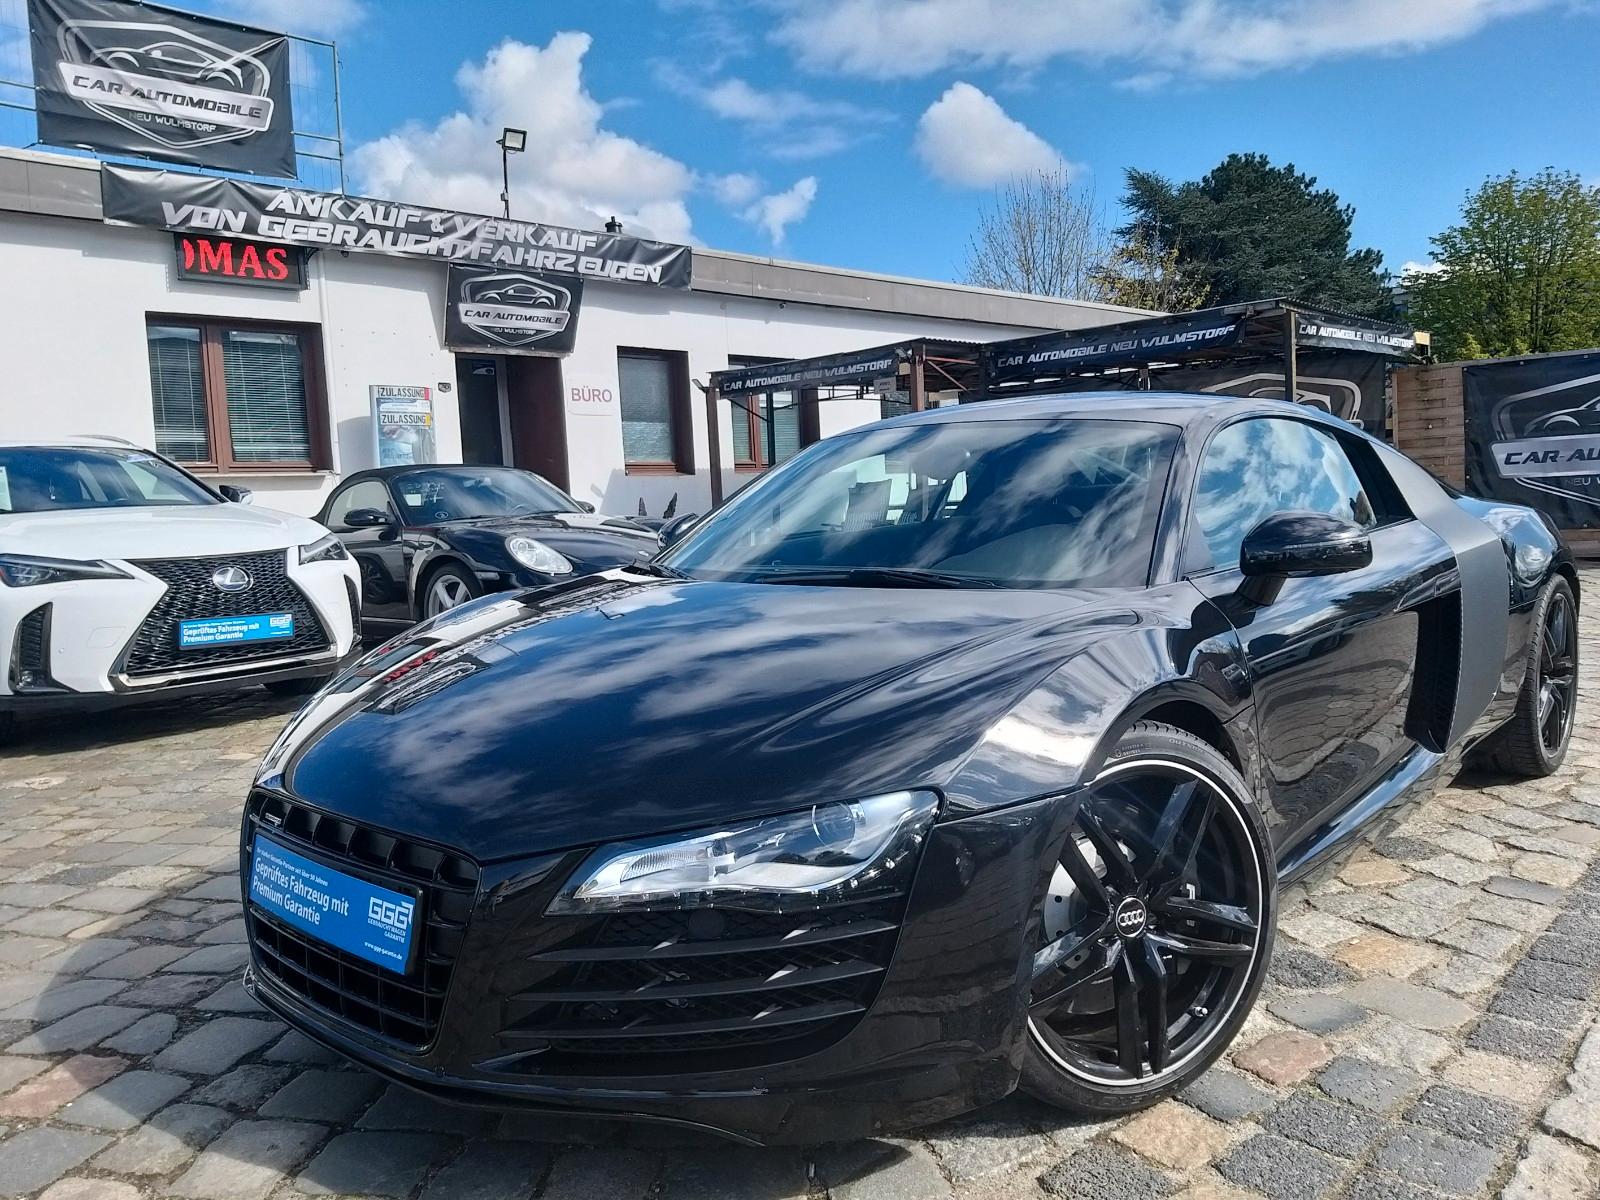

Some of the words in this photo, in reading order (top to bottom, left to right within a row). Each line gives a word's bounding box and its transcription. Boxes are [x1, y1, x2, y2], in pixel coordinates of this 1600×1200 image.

[72, 75, 123, 96] CAR
[129, 87, 262, 119] AUTOMOBILE
[129, 112, 151, 121] NEU
[155, 116, 216, 132] WULMSTORF
[162, 202, 248, 233] VON
[266, 192, 421, 228] ANKAUF
[430, 214, 445, 233] &
[454, 215, 598, 252] VERKAUF
[464, 309, 492, 318] CAR
[493, 311, 563, 324] AUTOMOBILE
[998, 355, 1023, 368] CAR
[1027, 344, 1107, 364] AUTOMOBILE
[1110, 340, 1138, 352] NEU
[1142, 324, 1236, 348] WULMSTORF
[1299, 325, 1317, 335] CAR
[1319, 326, 1362, 340] AUTOMOBILE
[1363, 333, 1376, 342] NEU
[1376, 335, 1414, 348] WULMSTORF
[724, 380, 742, 391] CAR
[745, 374, 801, 389] AUTOMOBILE
[803, 370, 822, 380] NEU
[825, 359, 893, 377] WULMSTORF
[380, 387, 424, 398] ZULASSUNG
[571, 385, 612, 402] BÜRO
[382, 414, 426, 424] ZULASSUNG
[184, 626, 218, 636] Geprüftes
[218, 624, 248, 632] Fahrzeug
[249, 622, 260, 630] mit
[184, 634, 214, 643] Premium
[215, 632, 244, 640] Garantie
[252, 875, 282, 906] Premium
[284, 894, 320, 925] Garantie
[255, 857, 288, 888] Geprüftes
[290, 874, 330, 912] Fahrzeug
[331, 897, 349, 916] mit
[368, 896, 410, 930] GGG
